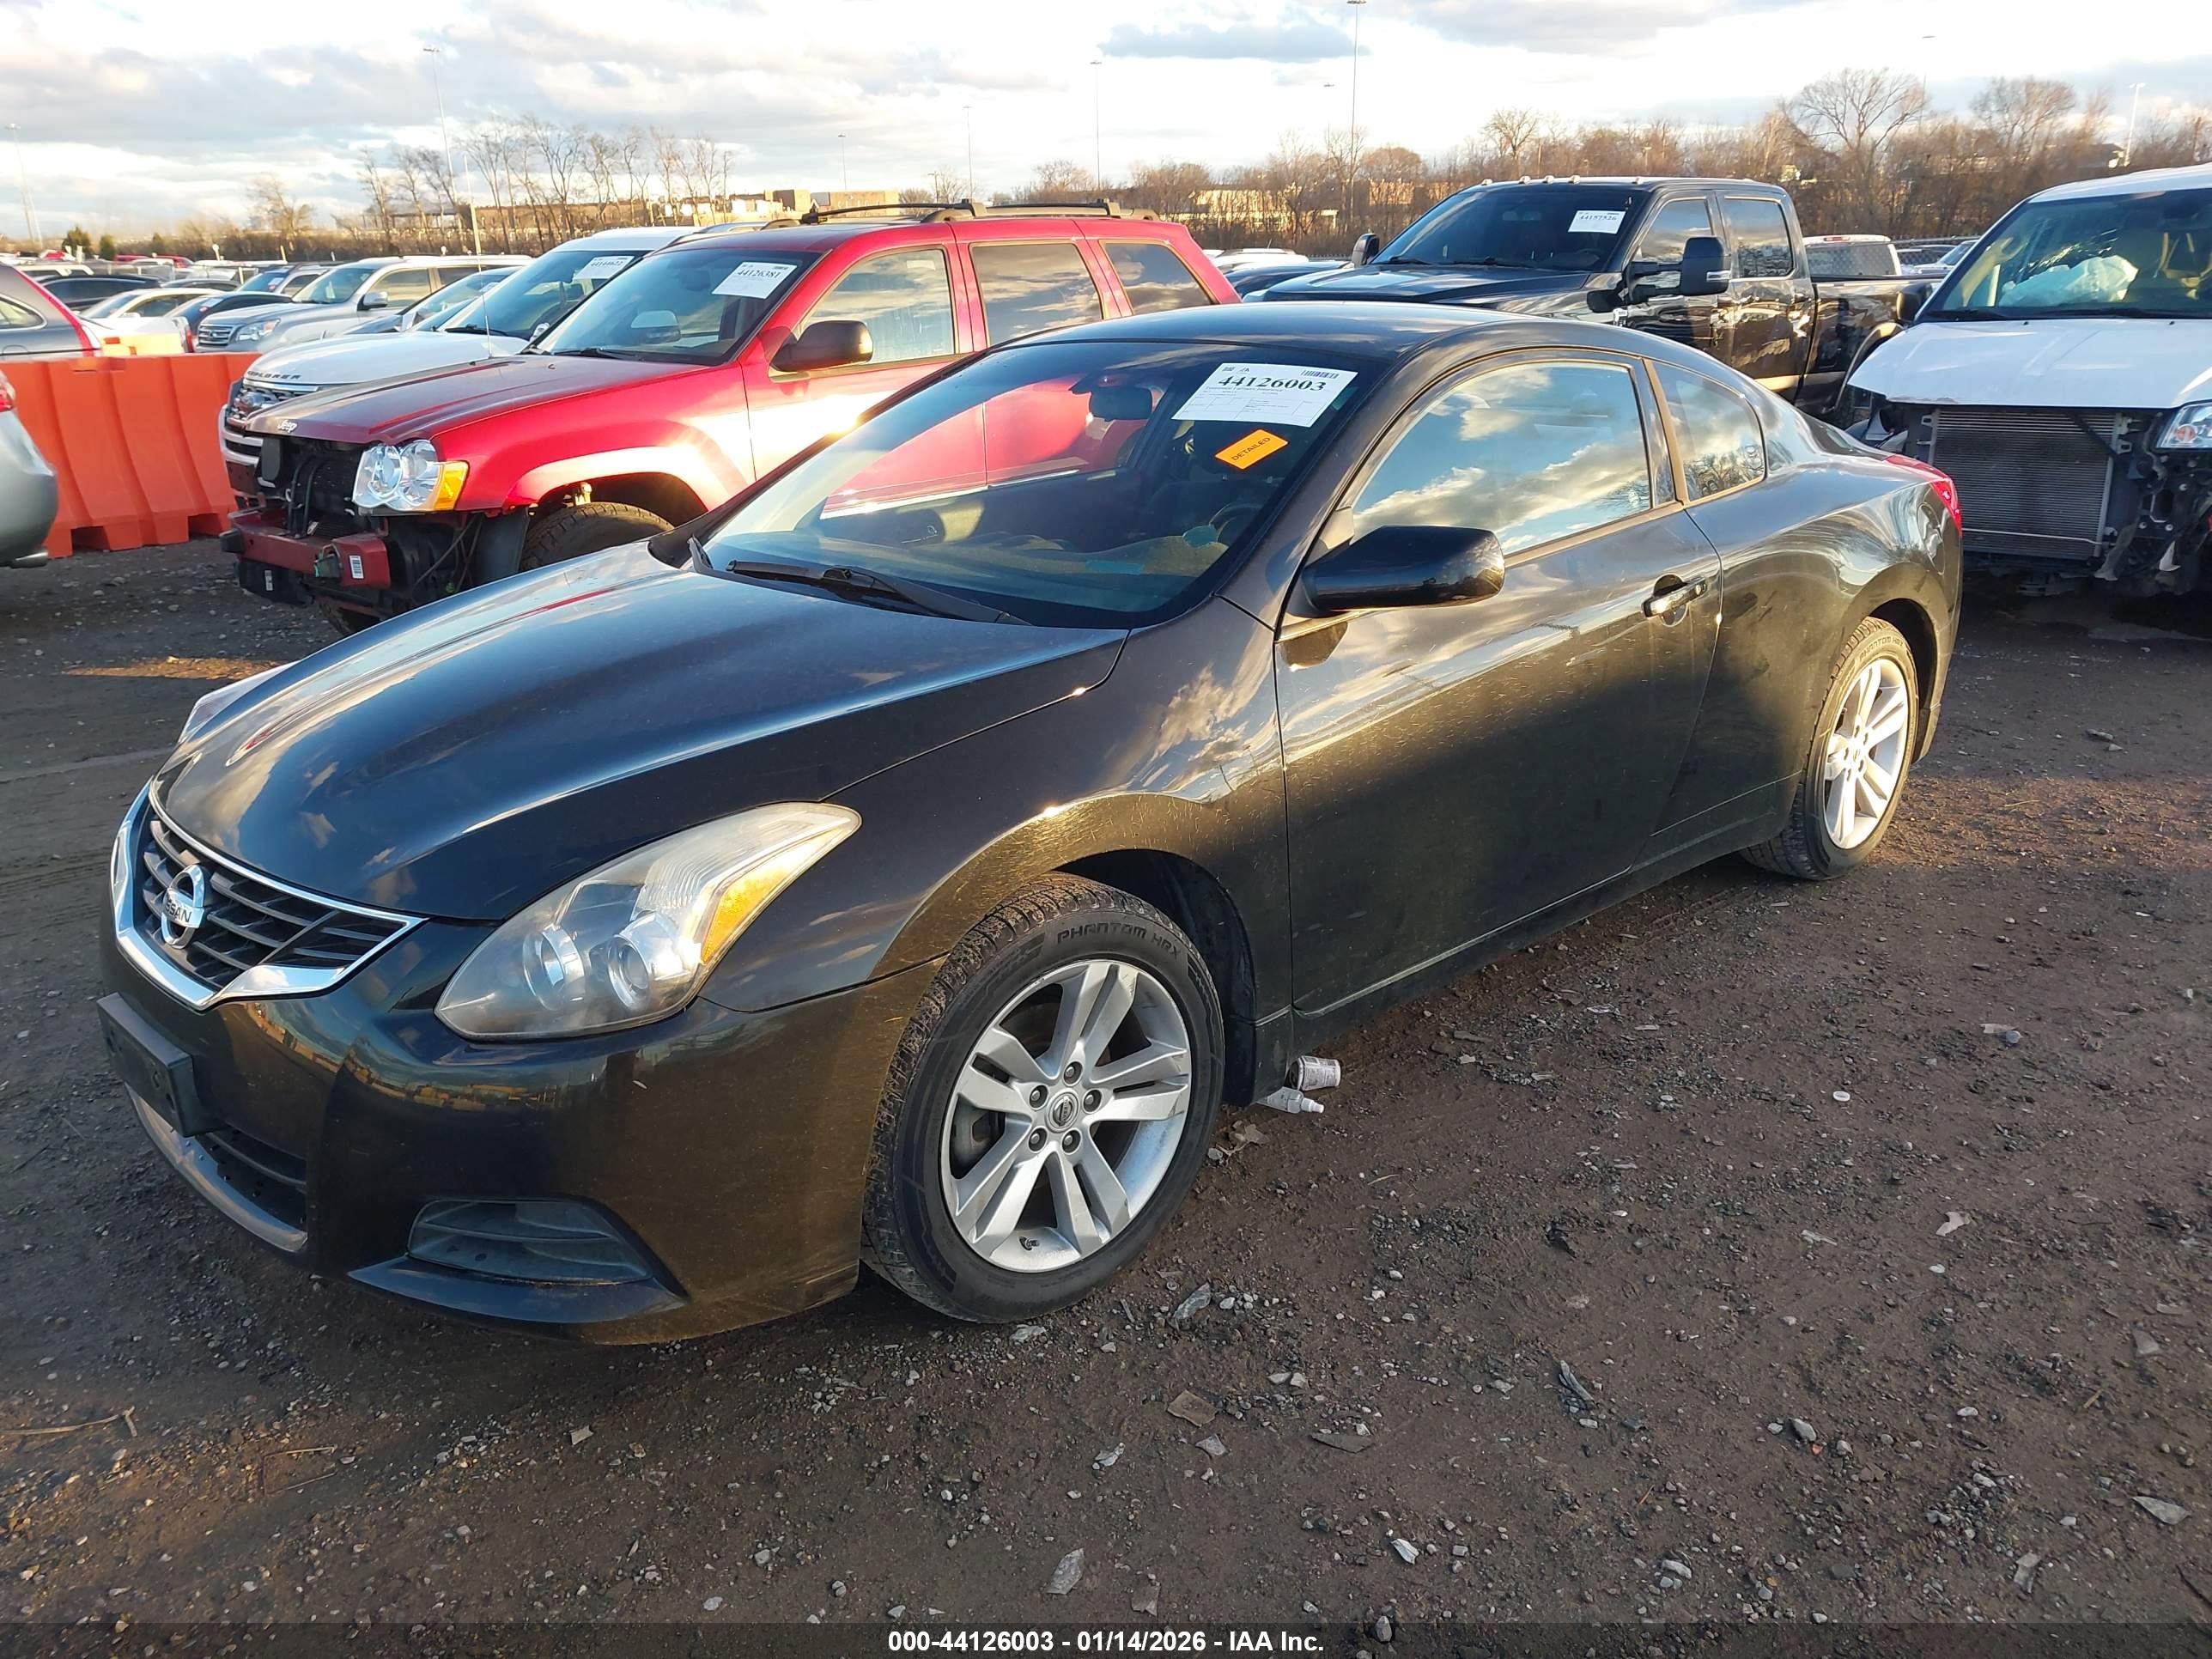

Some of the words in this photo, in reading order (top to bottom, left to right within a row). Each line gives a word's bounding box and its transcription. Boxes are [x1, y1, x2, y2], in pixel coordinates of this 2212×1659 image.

[1218, 374, 1327, 392] 44126003
[277, 419, 298, 434] Jeep
[1231, 436, 1271, 461] DETAILED
[1056, 921, 1147, 945] PHANTOM
